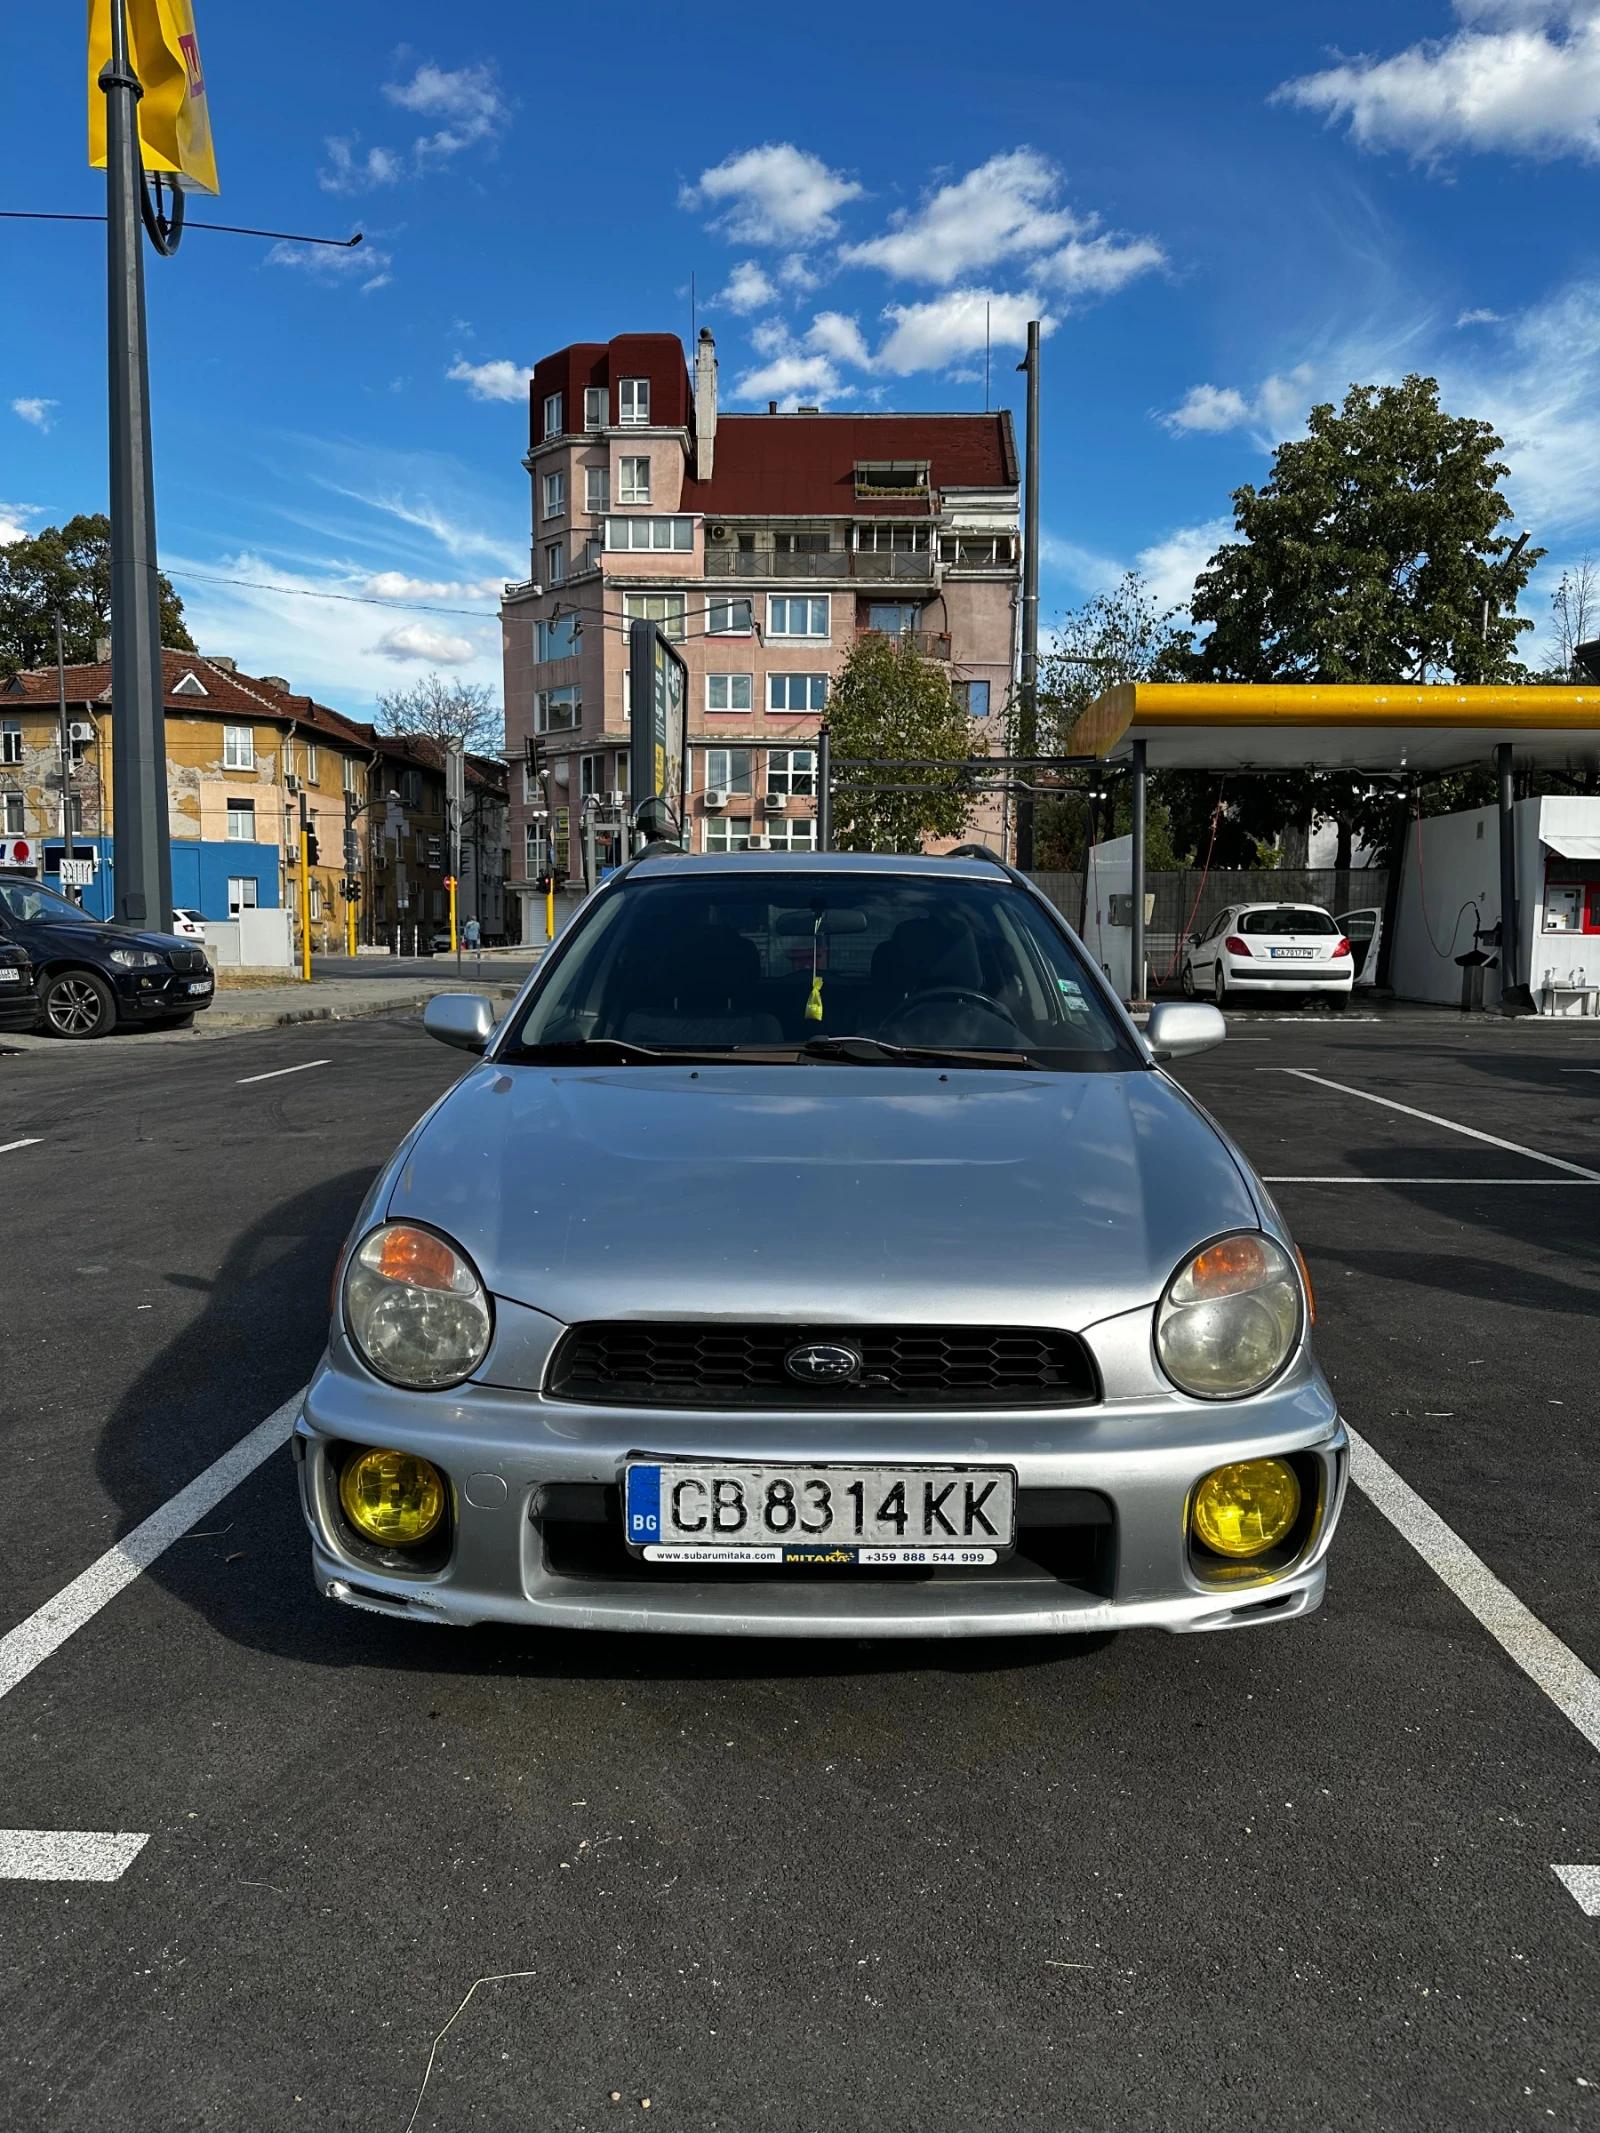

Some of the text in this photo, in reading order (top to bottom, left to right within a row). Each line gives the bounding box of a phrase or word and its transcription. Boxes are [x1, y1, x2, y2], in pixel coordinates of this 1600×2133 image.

[633, 1514, 657, 1531] BG
[656, 1551, 776, 1561] www.subarumitaka.com
[786, 1553, 848, 1563] MITAKA
[865, 1553, 985, 1562] +359 888 544 999
